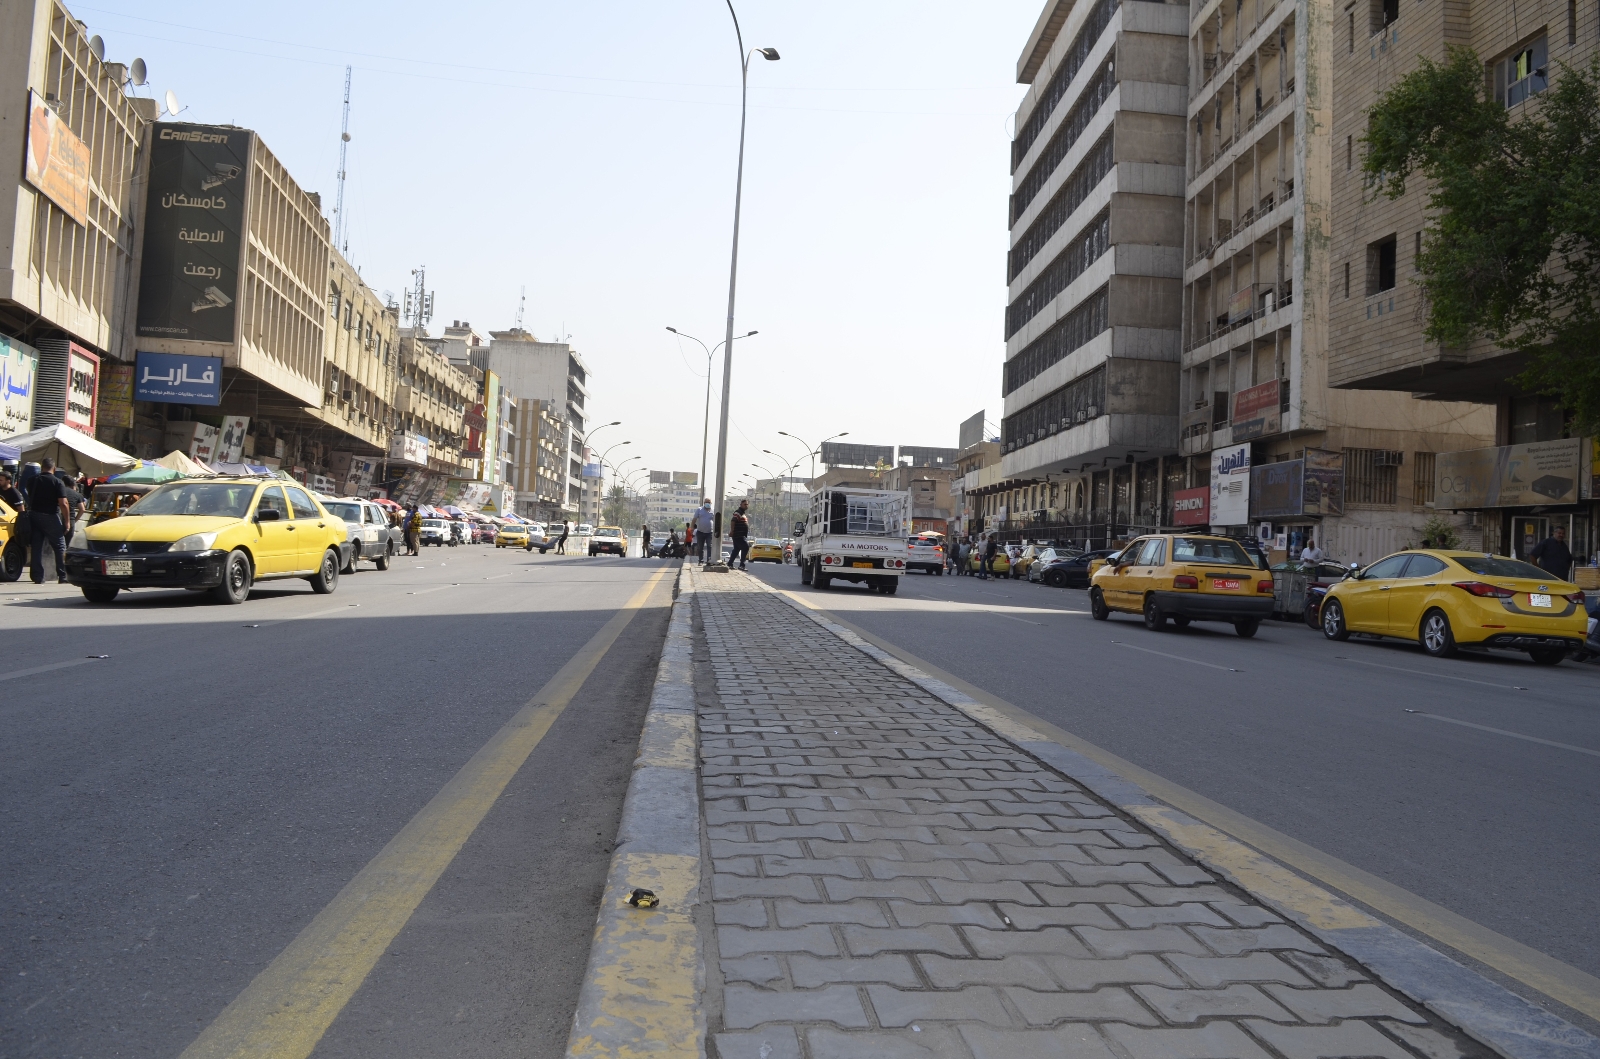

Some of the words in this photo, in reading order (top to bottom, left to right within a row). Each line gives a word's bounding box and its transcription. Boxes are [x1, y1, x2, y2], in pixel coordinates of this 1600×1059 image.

[162, 192, 226, 209] كامسكان
[178, 227, 224, 244] الاصلية
[183, 262, 221, 279] رجعت
[140, 325, 188, 334] www.camscan.ca
[1219, 448, 1245, 475] النهرين
[1174, 497, 1204, 511] SHINON
[856, 543, 889, 551] MOTORS
